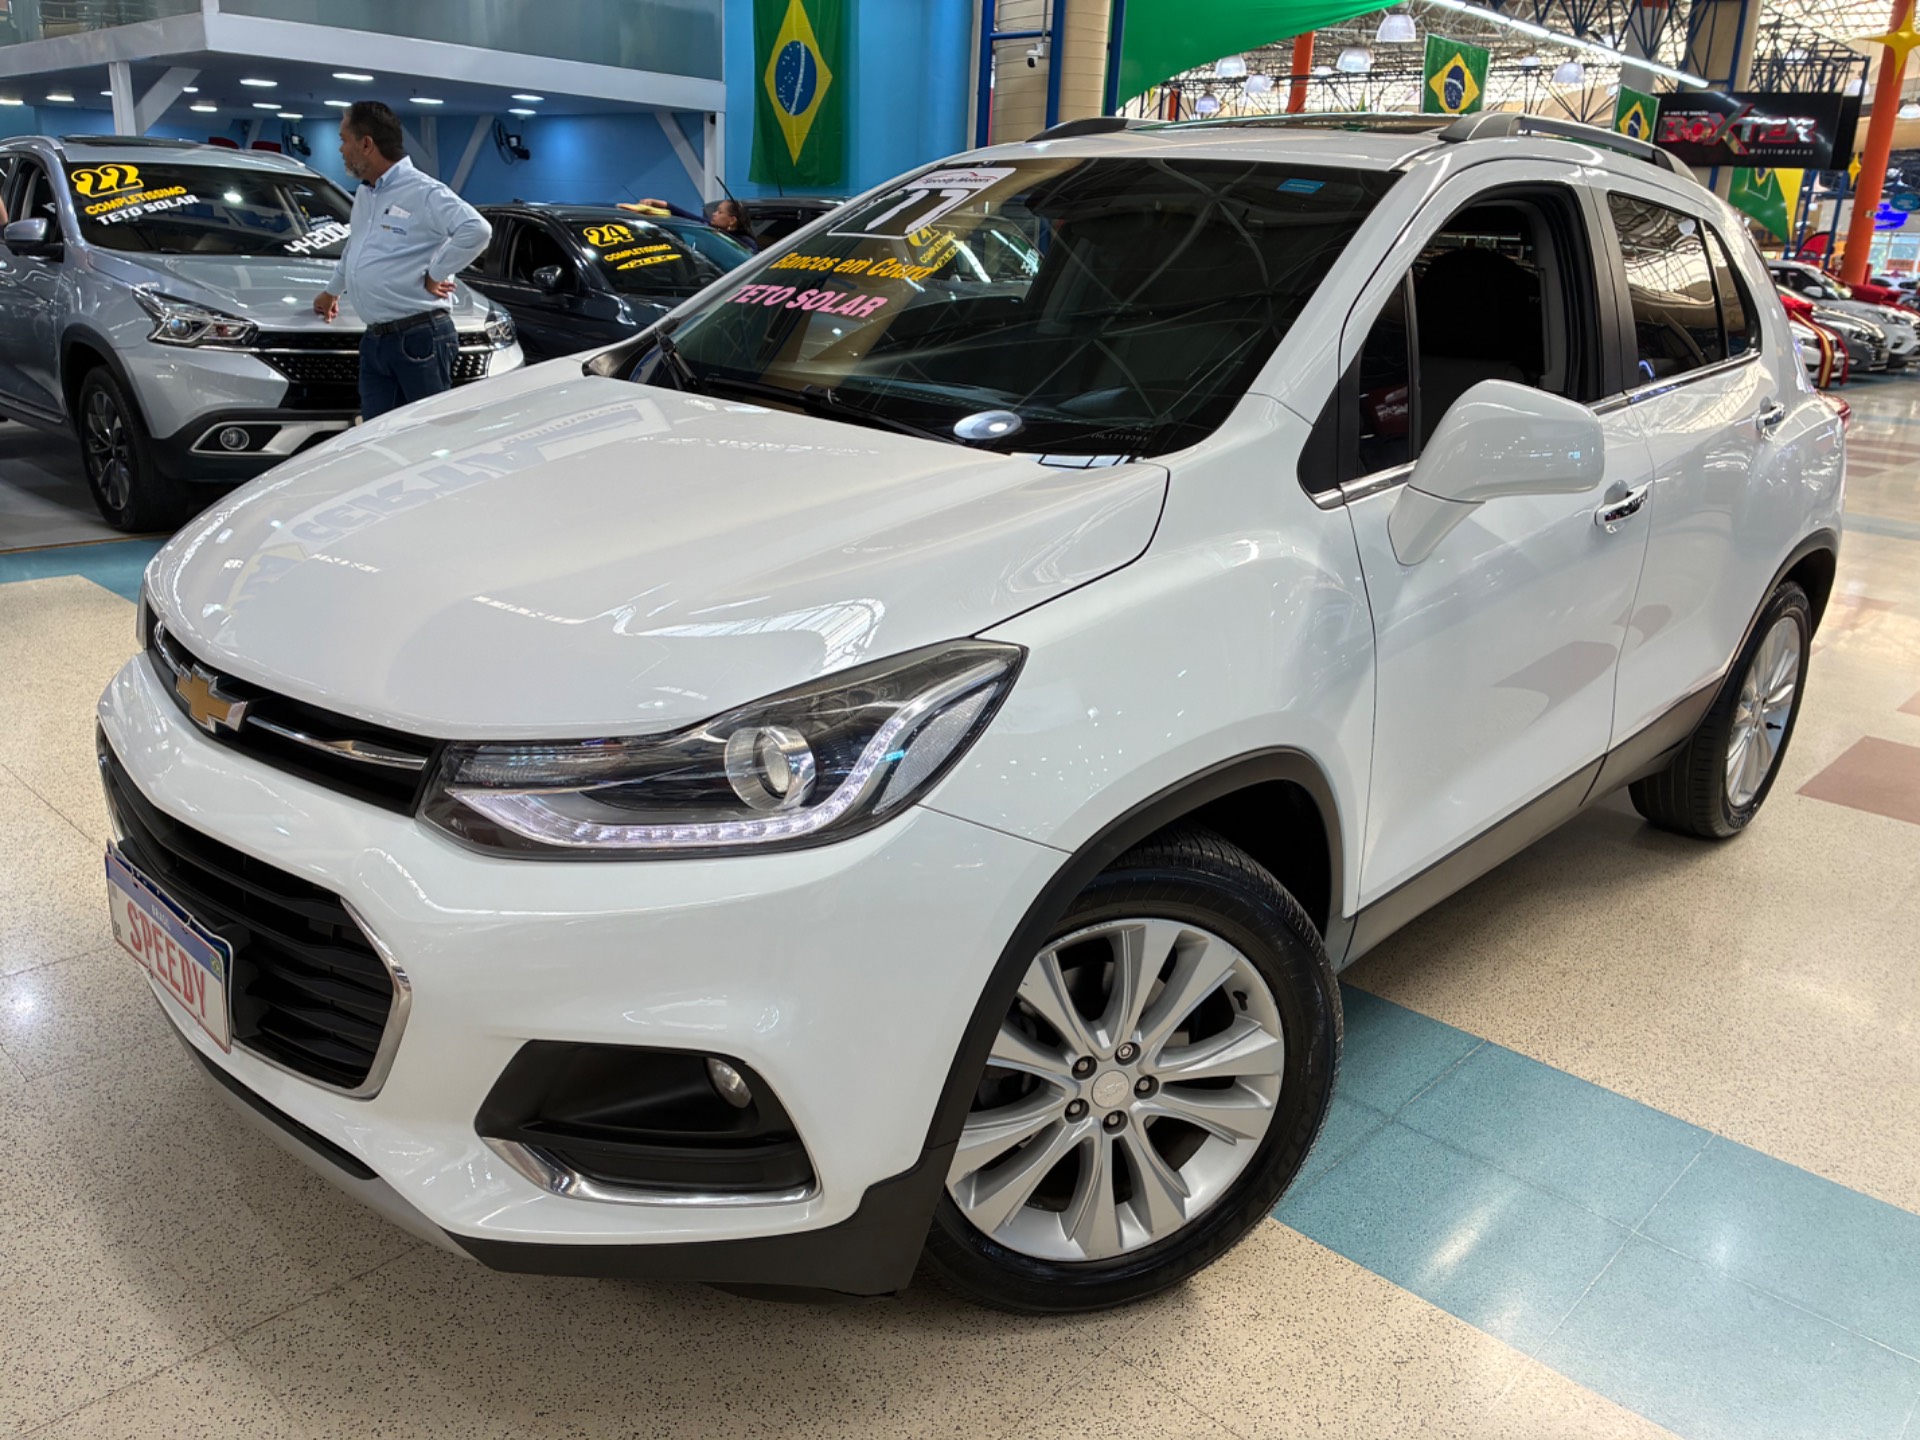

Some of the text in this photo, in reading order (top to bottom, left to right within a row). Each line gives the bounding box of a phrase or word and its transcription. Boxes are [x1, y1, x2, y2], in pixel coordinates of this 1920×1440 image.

[1658, 103, 1816, 155] BOXTER
[72, 164, 144, 198] 22
[96, 194, 200, 226] TETO SOLAR
[864, 189, 970, 234] 17
[583, 224, 635, 248] 24
[769, 252, 934, 281] Bancos em Couro
[726, 285, 888, 318] TETO SOLAR
[127, 900, 205, 1018] SPEEDY
